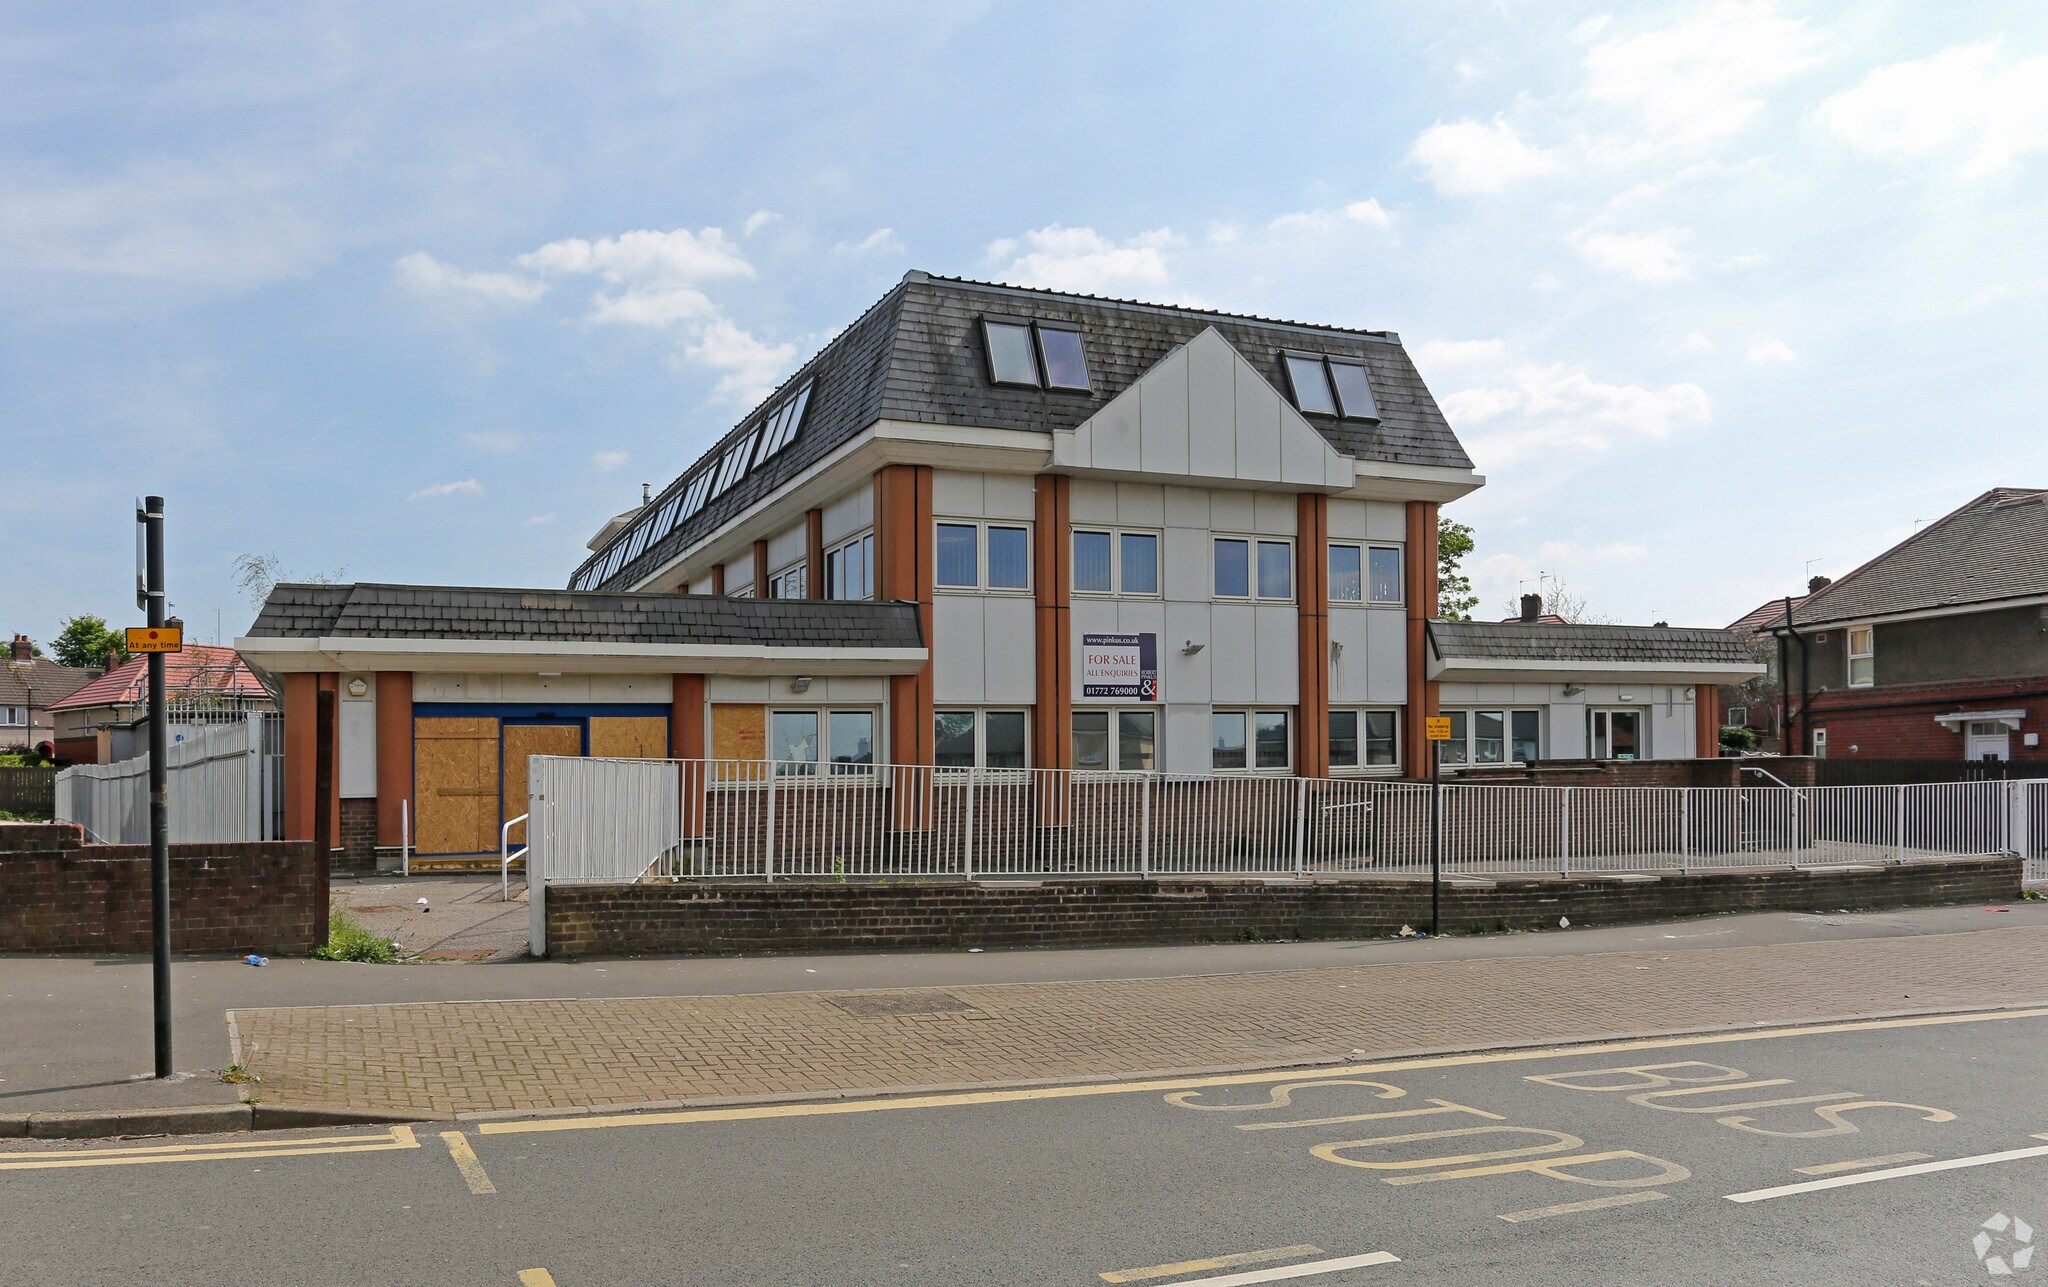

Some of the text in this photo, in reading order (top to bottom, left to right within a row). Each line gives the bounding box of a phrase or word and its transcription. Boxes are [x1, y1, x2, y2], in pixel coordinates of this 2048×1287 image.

[1086, 636, 1139, 644] www.pinkus.co.uk
[1088, 655, 1136, 665] FOR SALE
[1087, 669, 1138, 678] ALL ENQUIRIES
[1086, 687, 1138, 695] 01772 769000
[1140, 679, 1156, 695] &
[1521, 1061, 1958, 1140] BUS
[1163, 1080, 1693, 1189] STOP
